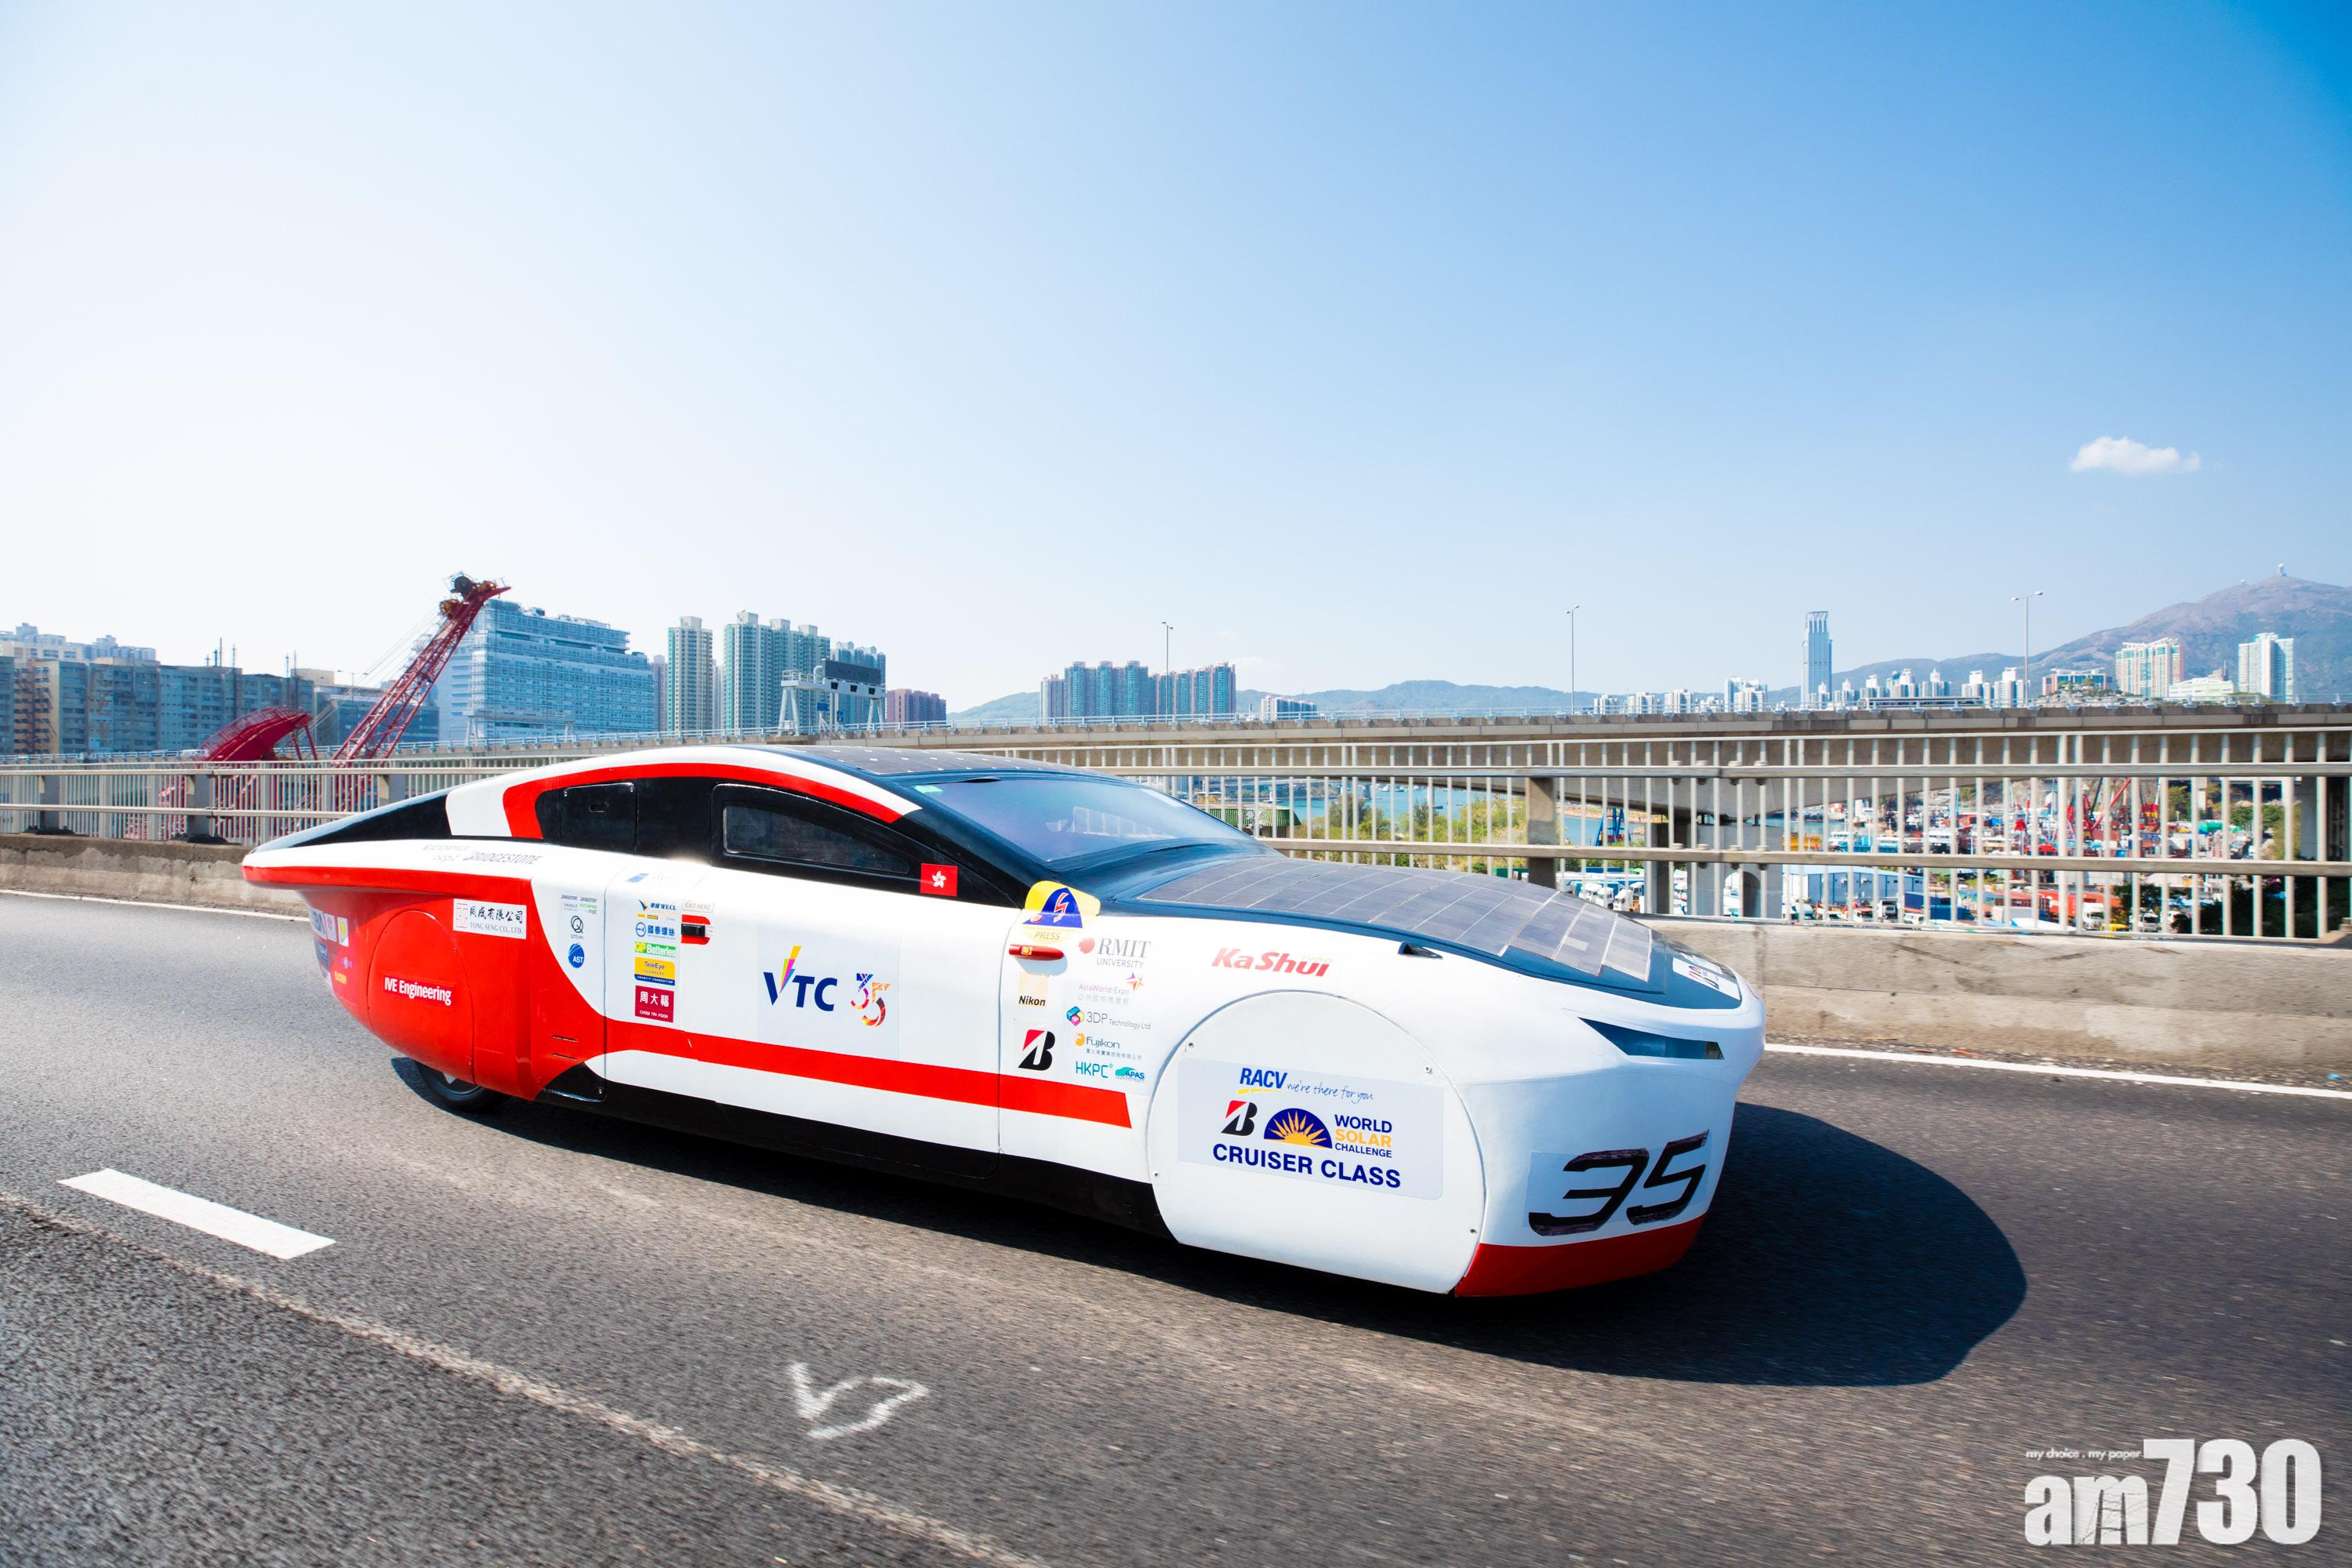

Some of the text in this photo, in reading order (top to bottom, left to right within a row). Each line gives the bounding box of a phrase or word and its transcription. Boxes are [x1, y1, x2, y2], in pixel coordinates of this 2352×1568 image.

[1034, 931, 1061, 941] PRESS
[646, 942, 677, 957] Batteries
[1097, 938, 1151, 959] RMIT
[572, 955, 584, 964] AST
[644, 960, 666, 971] TeleEye
[1096, 957, 1145, 969] UNIVERSITY
[763, 945, 838, 1012] VTC
[384, 977, 452, 1006] IVE Engineering
[1079, 983, 1130, 996] AsiaWorld-Expo
[640, 990, 670, 1007] 周大福
[1018, 995, 1046, 1007] Nikon
[1086, 1011, 1109, 1025] 3DP
[1109, 1018, 1141, 1030] Technology
[1123, 1070, 1145, 1080] APAS
[1240, 1067, 1374, 1104] RACV we're there for you
[1334, 1114, 1392, 1133] WORLD
[1334, 1128, 1392, 1149] SOLAR
[1334, 1142, 1392, 1158] CHALLENGE
[1213, 1143, 1402, 1189] CRUISER CLASS
[1529, 1128, 1710, 1237] 35
